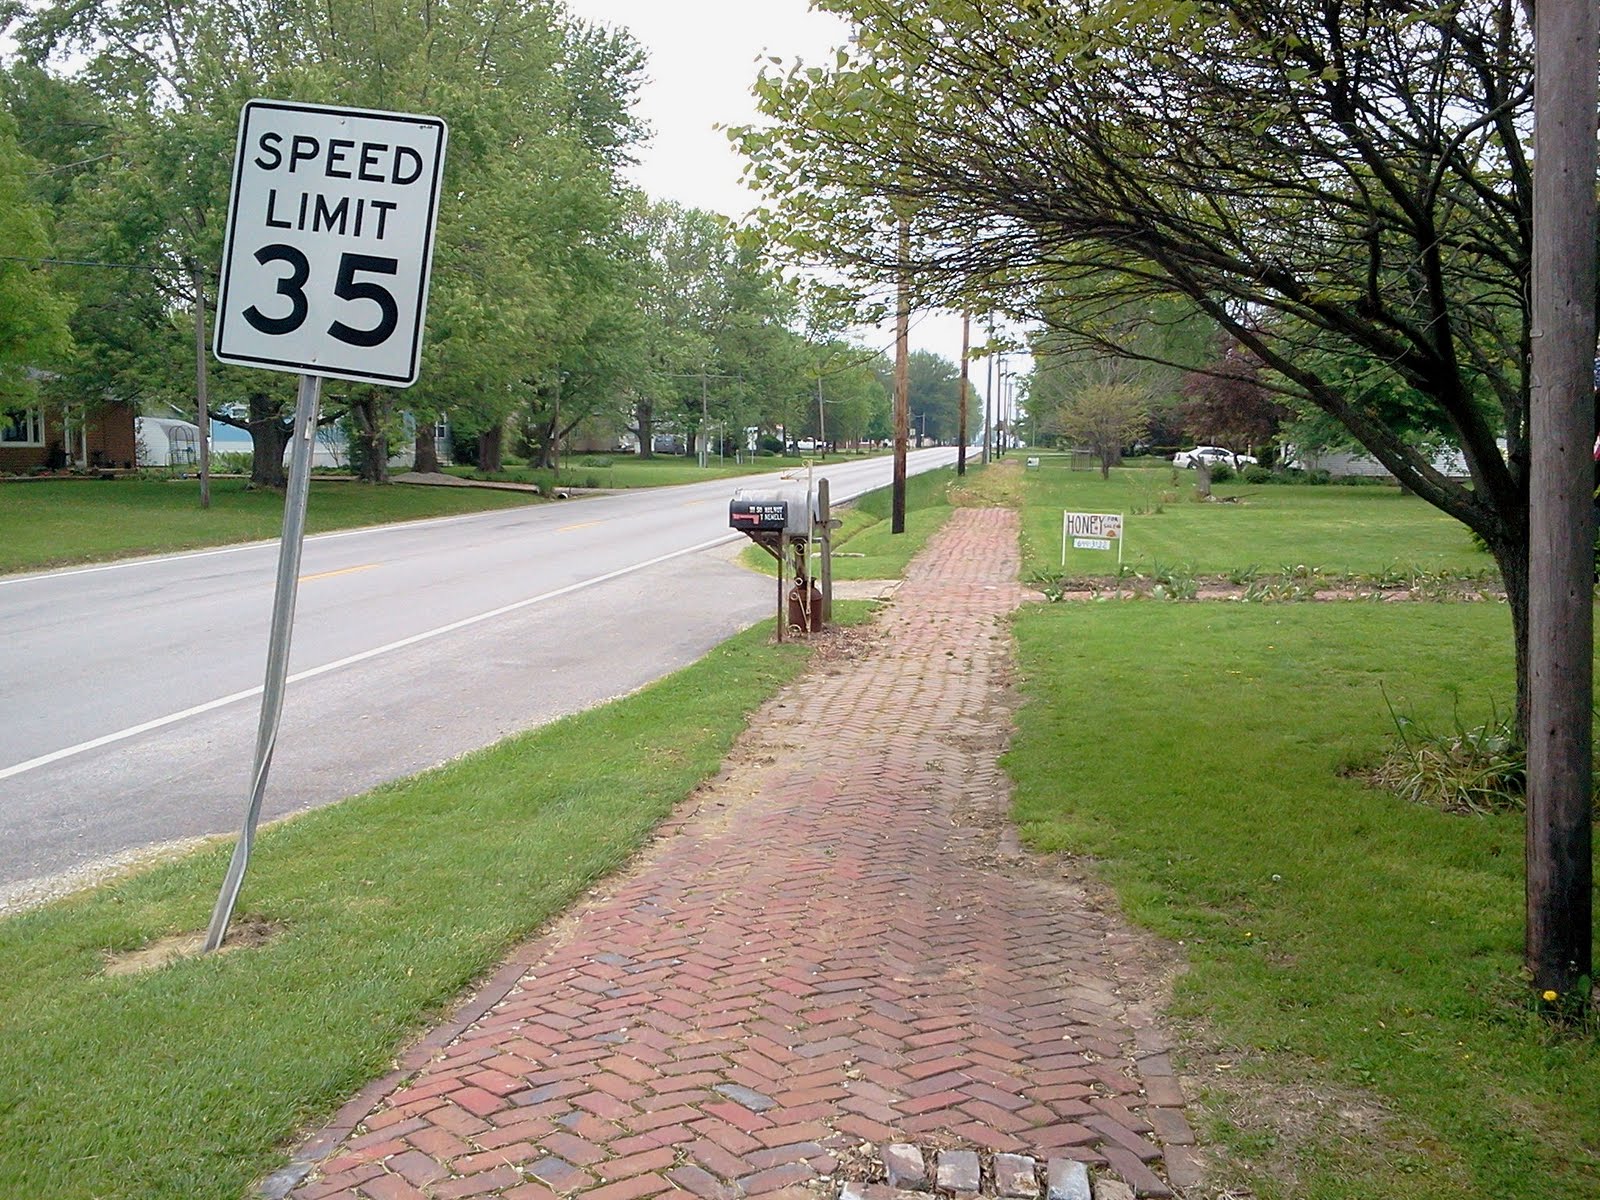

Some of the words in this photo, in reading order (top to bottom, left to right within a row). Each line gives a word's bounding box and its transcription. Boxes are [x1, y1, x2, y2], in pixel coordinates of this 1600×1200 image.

[254, 132, 423, 185] SPEED
[265, 189, 397, 240] LIMIT
[242, 244, 398, 347] 35
[1067, 515, 1104, 535] HONEY
